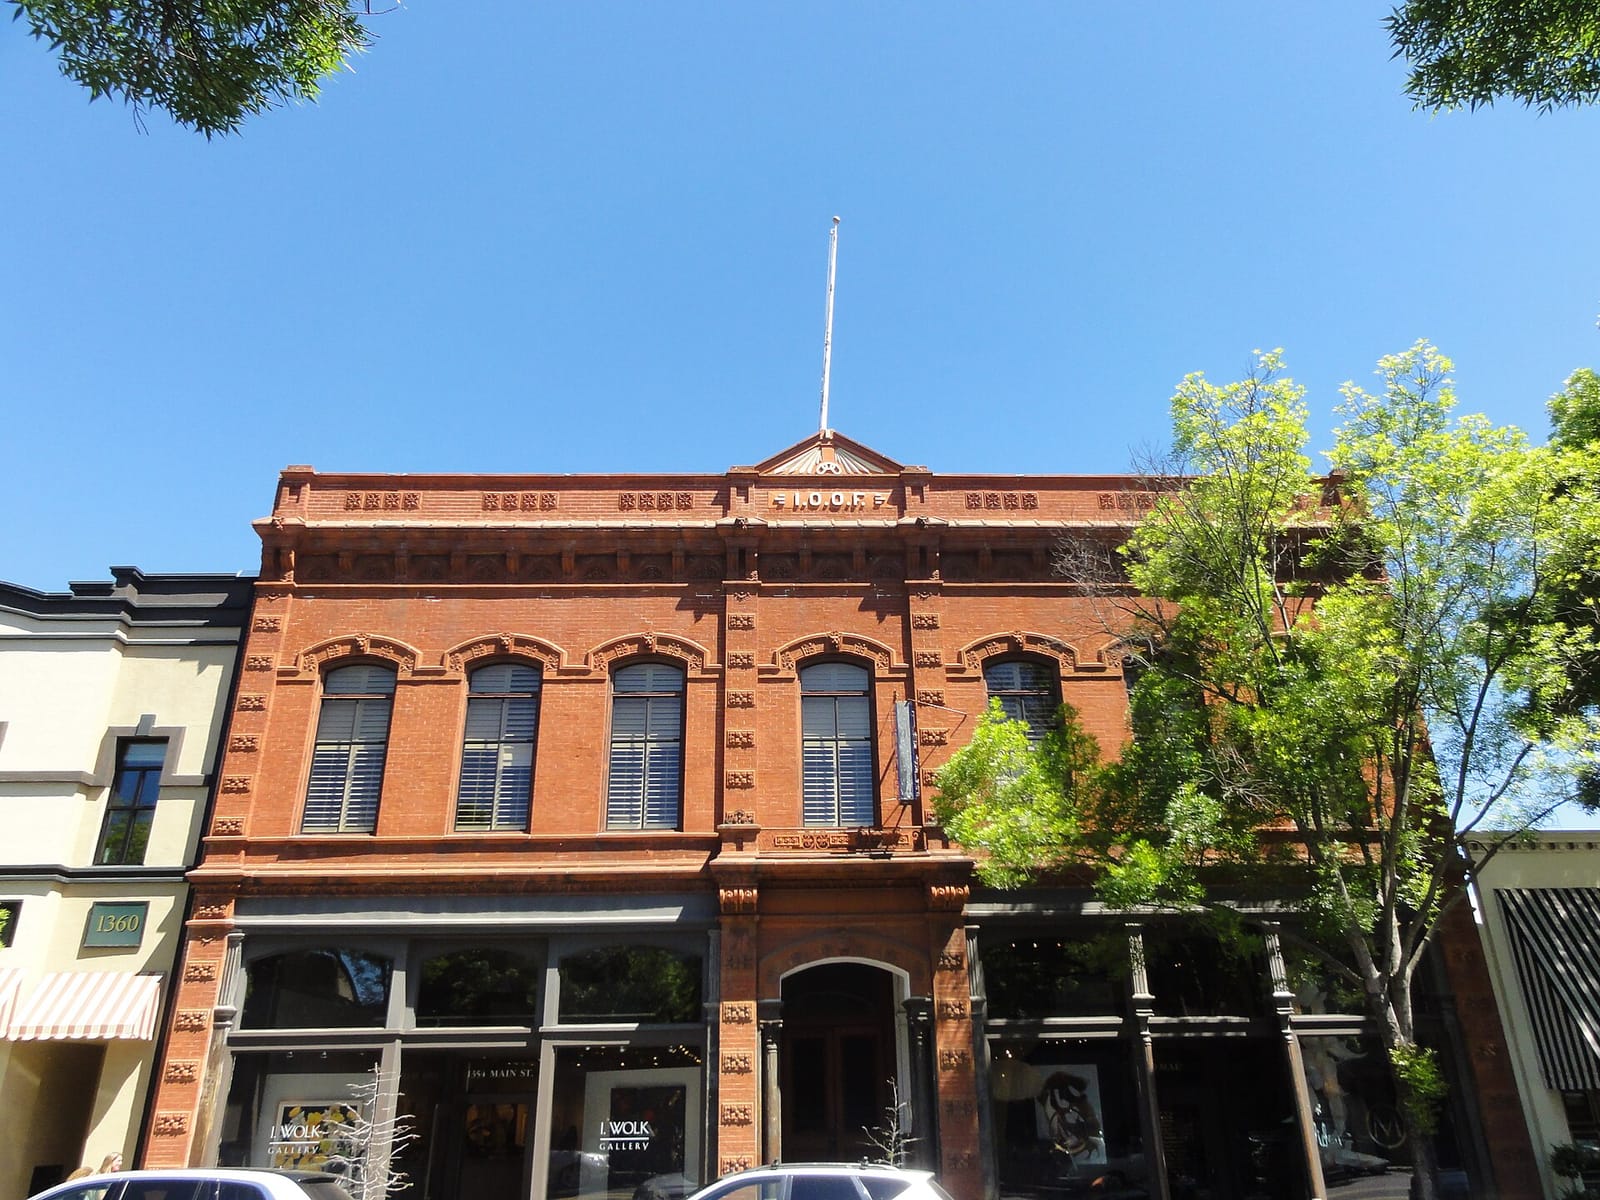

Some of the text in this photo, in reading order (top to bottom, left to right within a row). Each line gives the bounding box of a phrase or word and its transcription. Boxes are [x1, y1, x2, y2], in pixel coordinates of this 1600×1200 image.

[794, 492, 866, 507] I.O.O.F.
[96, 913, 140, 932] 1360
[490, 1069, 516, 1077] MAIN
[280, 1124, 321, 1139] WOLK
[600, 1120, 650, 1135] I. WOLK
[267, 1145, 320, 1155] GALLERY
[599, 1141, 650, 1151] GALLERY
